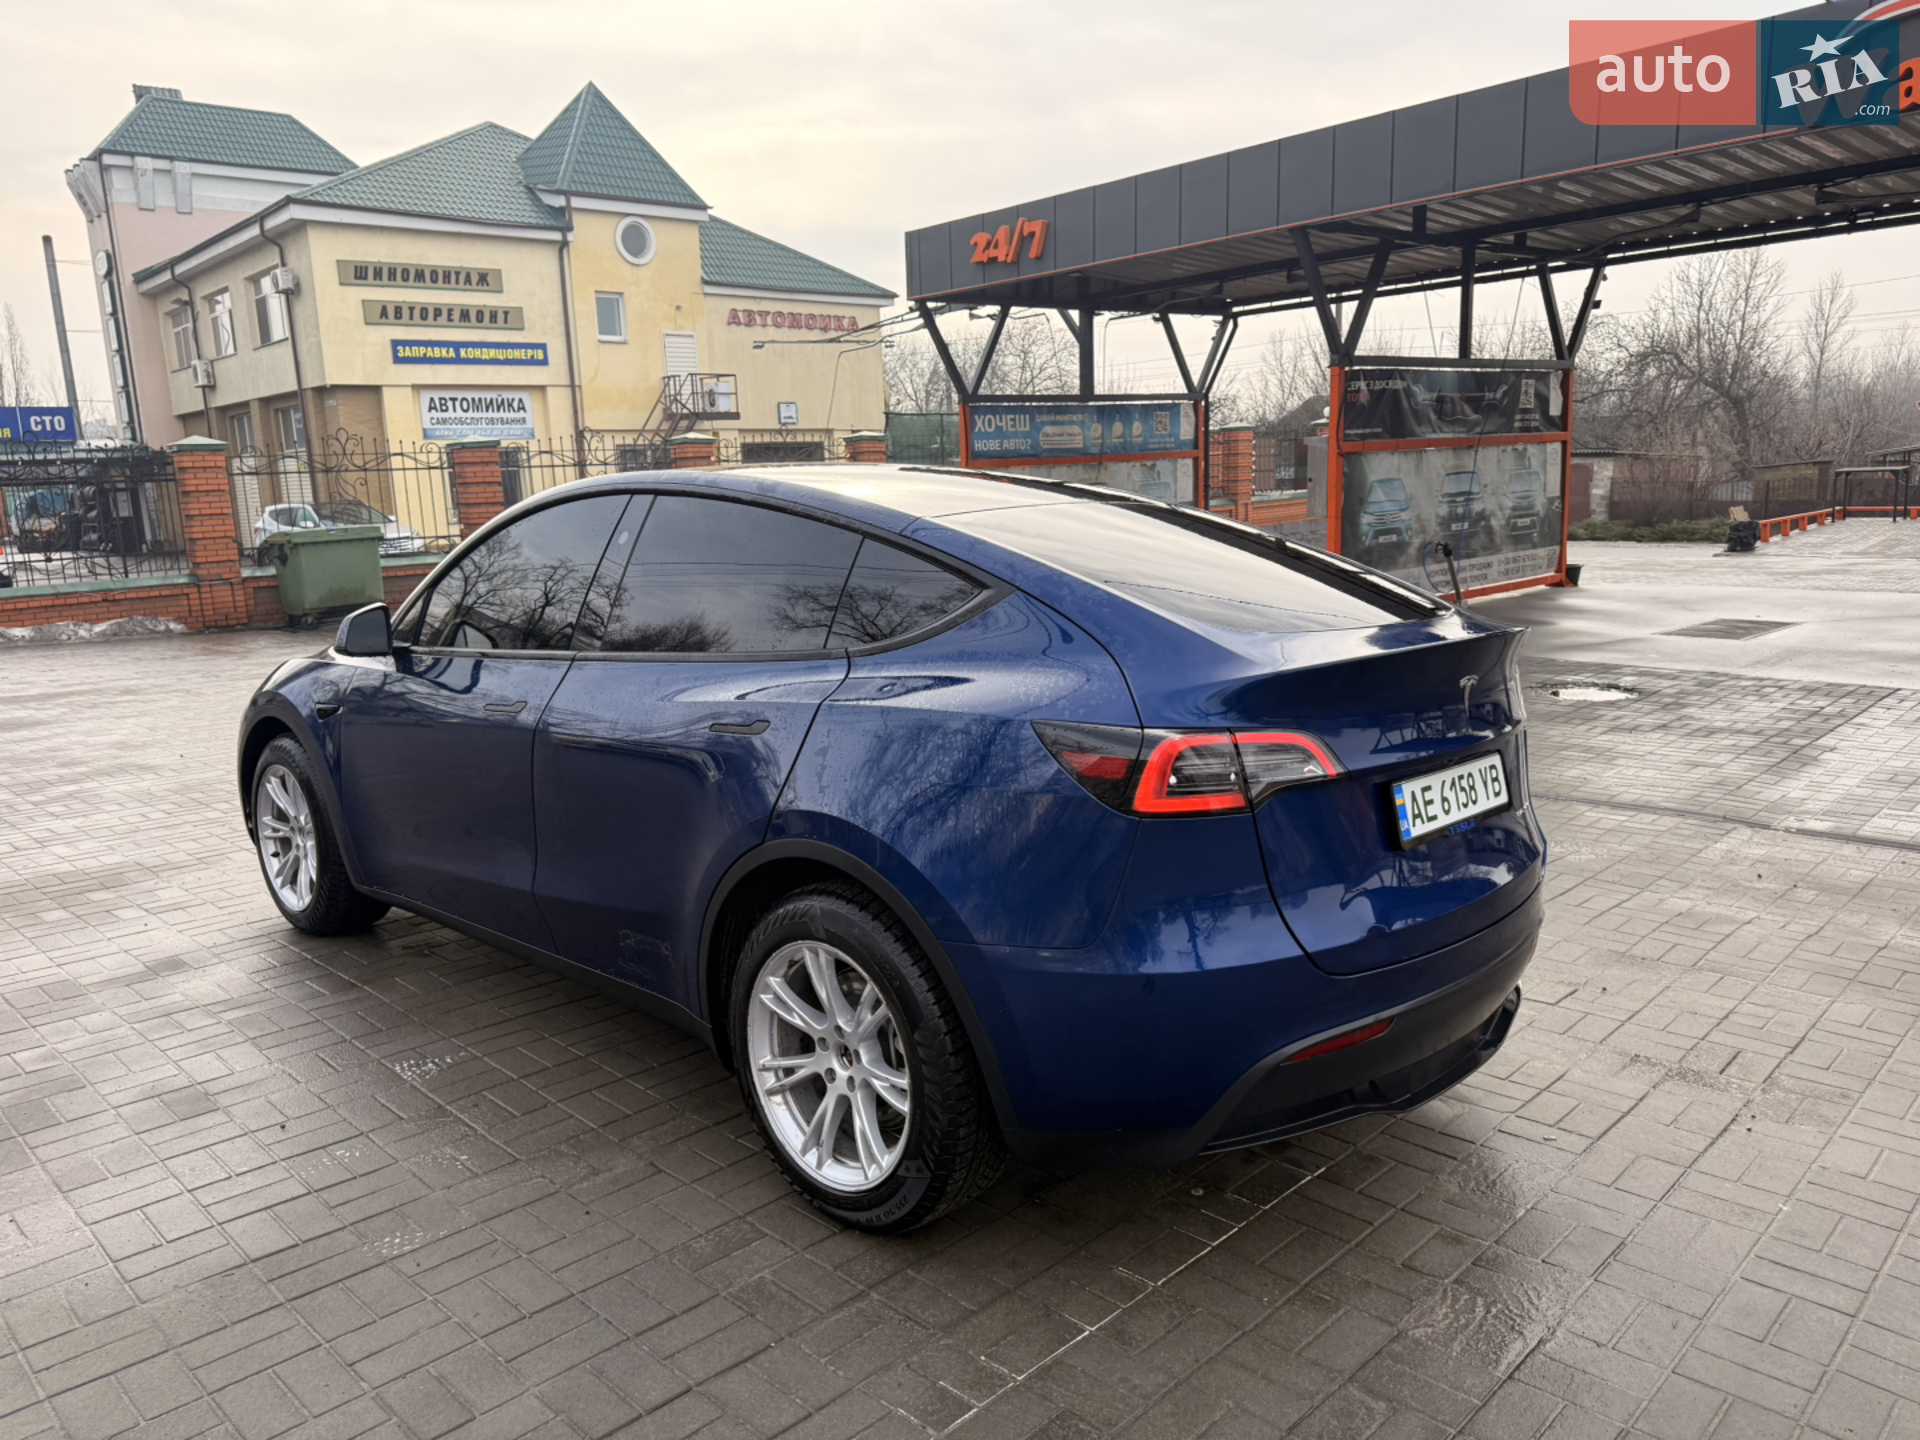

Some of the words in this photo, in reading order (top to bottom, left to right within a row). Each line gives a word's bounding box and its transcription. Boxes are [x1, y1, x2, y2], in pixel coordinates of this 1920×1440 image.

[970, 217, 1049, 264] 24/7
[353, 264, 490, 287] ШИНОМОНТАЖ
[379, 304, 510, 325] АВТОРЕМОНТ
[396, 345, 456, 358] ЗАПРАВКА
[460, 347, 545, 361] КОНДИЦІОНЕРІВ
[427, 393, 527, 413] АВТОМИЙКА
[30, 415, 67, 431] СТО
[429, 416, 527, 426] САМООБСЛУГОВУВАННЯ
[974, 413, 1031, 432] ХОЧЕШ
[974, 439, 1001, 451] НОВЕ
[1003, 439, 1031, 450] АВТО?
[1411, 785, 1438, 827] AE
[1441, 771, 1478, 816] 6158
[1478, 764, 1502, 801] YB
